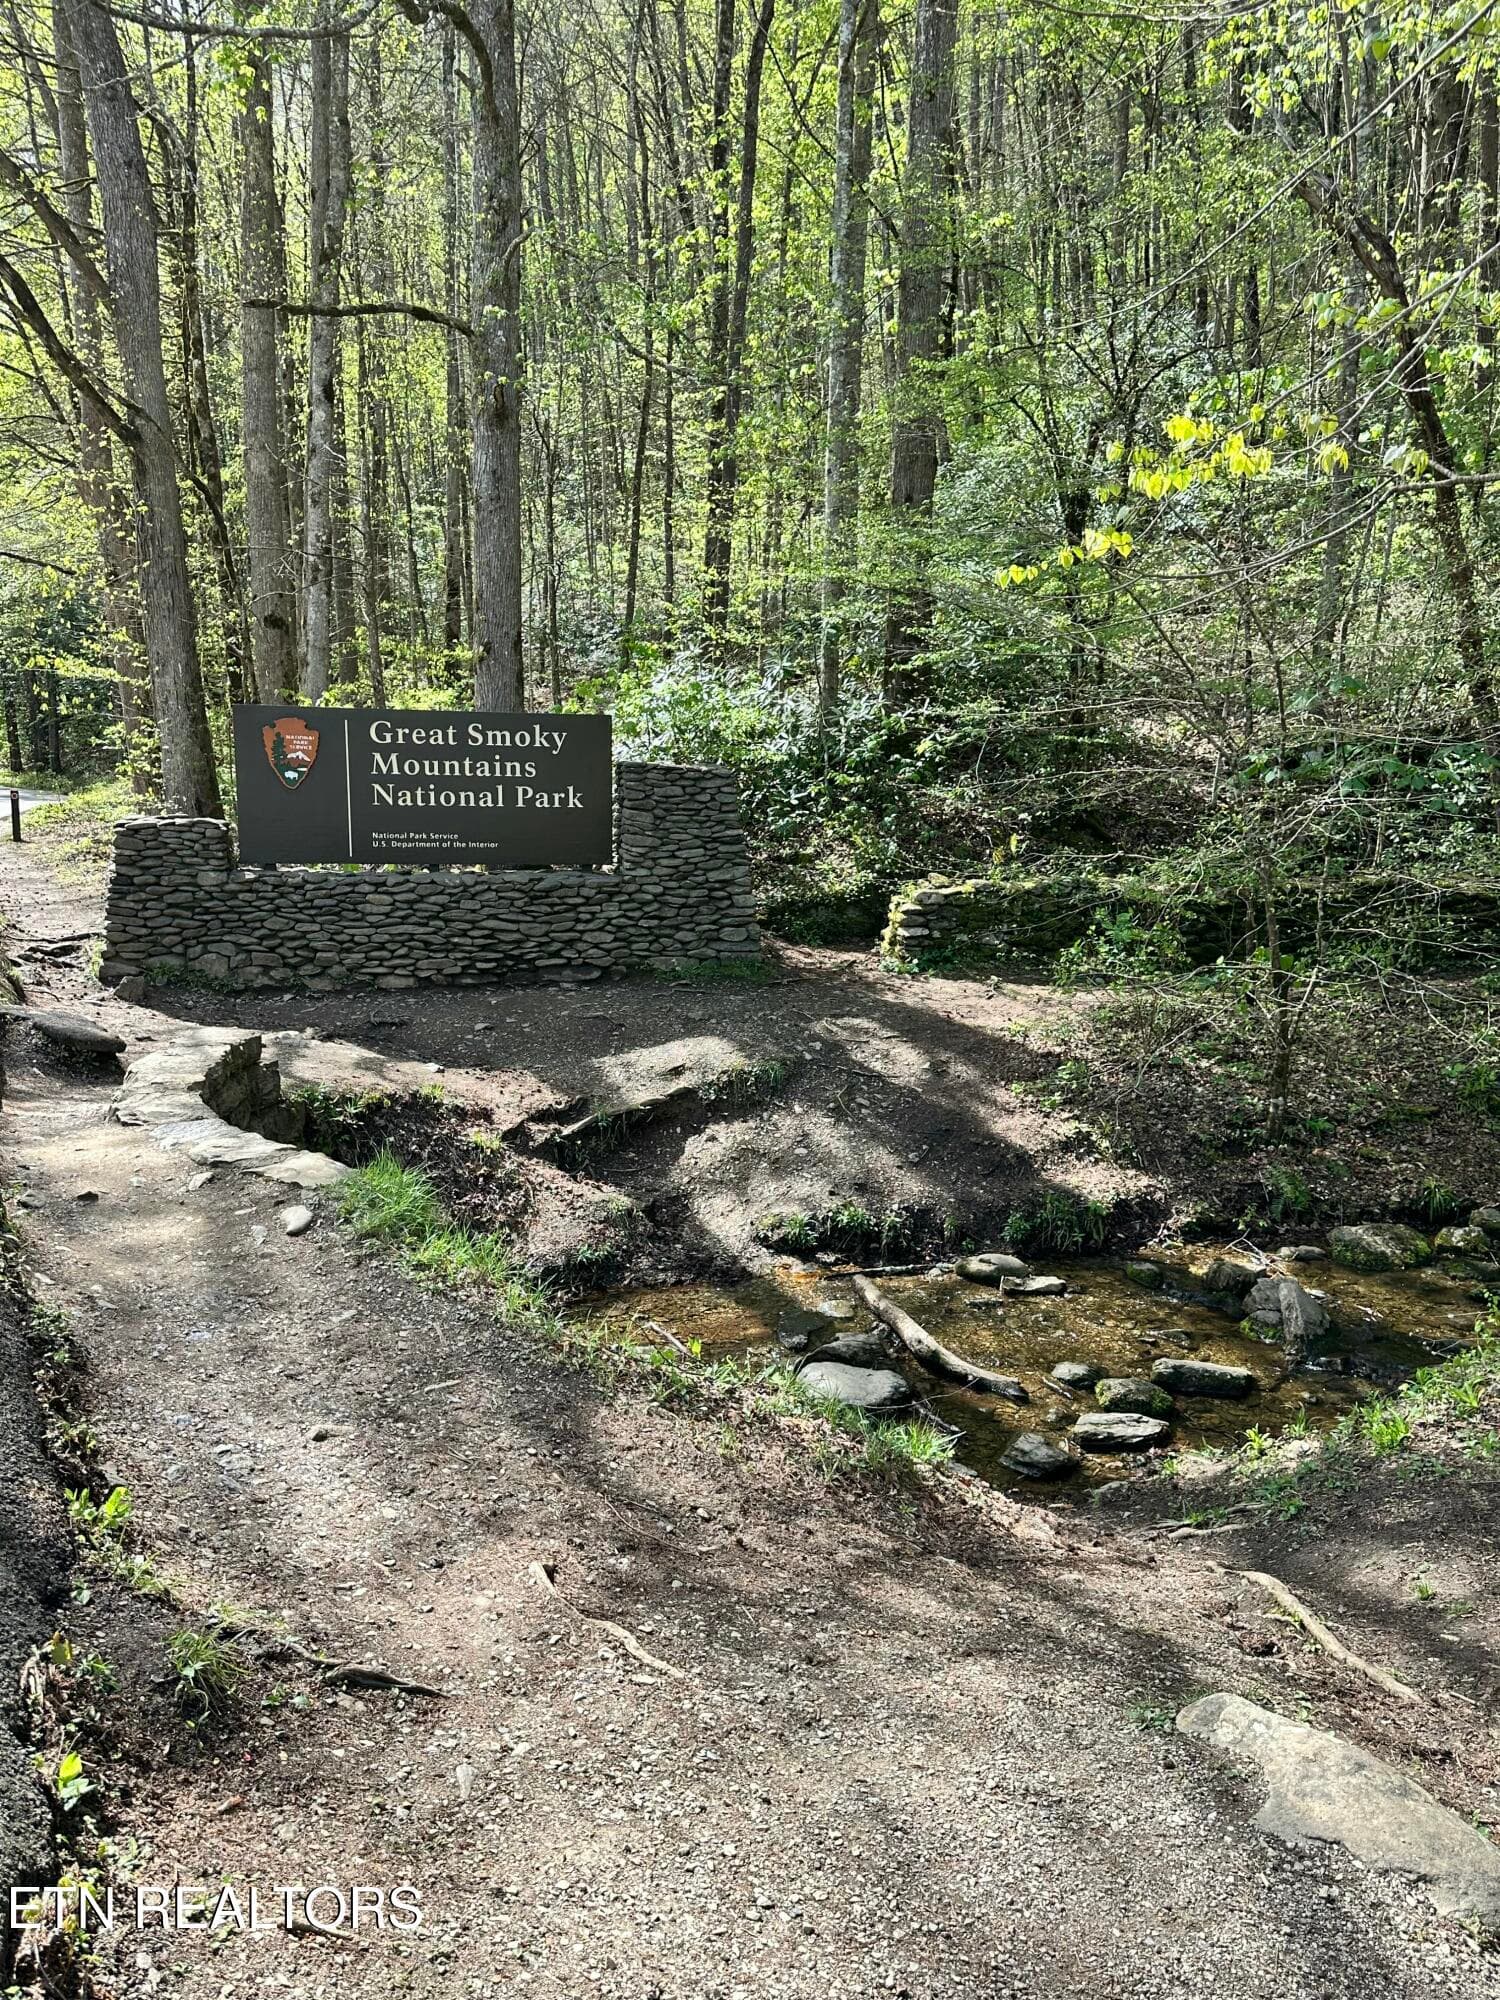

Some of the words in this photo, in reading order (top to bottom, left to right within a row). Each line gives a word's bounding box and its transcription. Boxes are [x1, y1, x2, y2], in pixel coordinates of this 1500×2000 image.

[369, 720, 458, 745] Great
[467, 723, 567, 755] Smoky
[370, 752, 537, 778] Mountains
[371, 783, 504, 807] National
[515, 785, 584, 808] Park
[391, 841, 440, 849] Department
